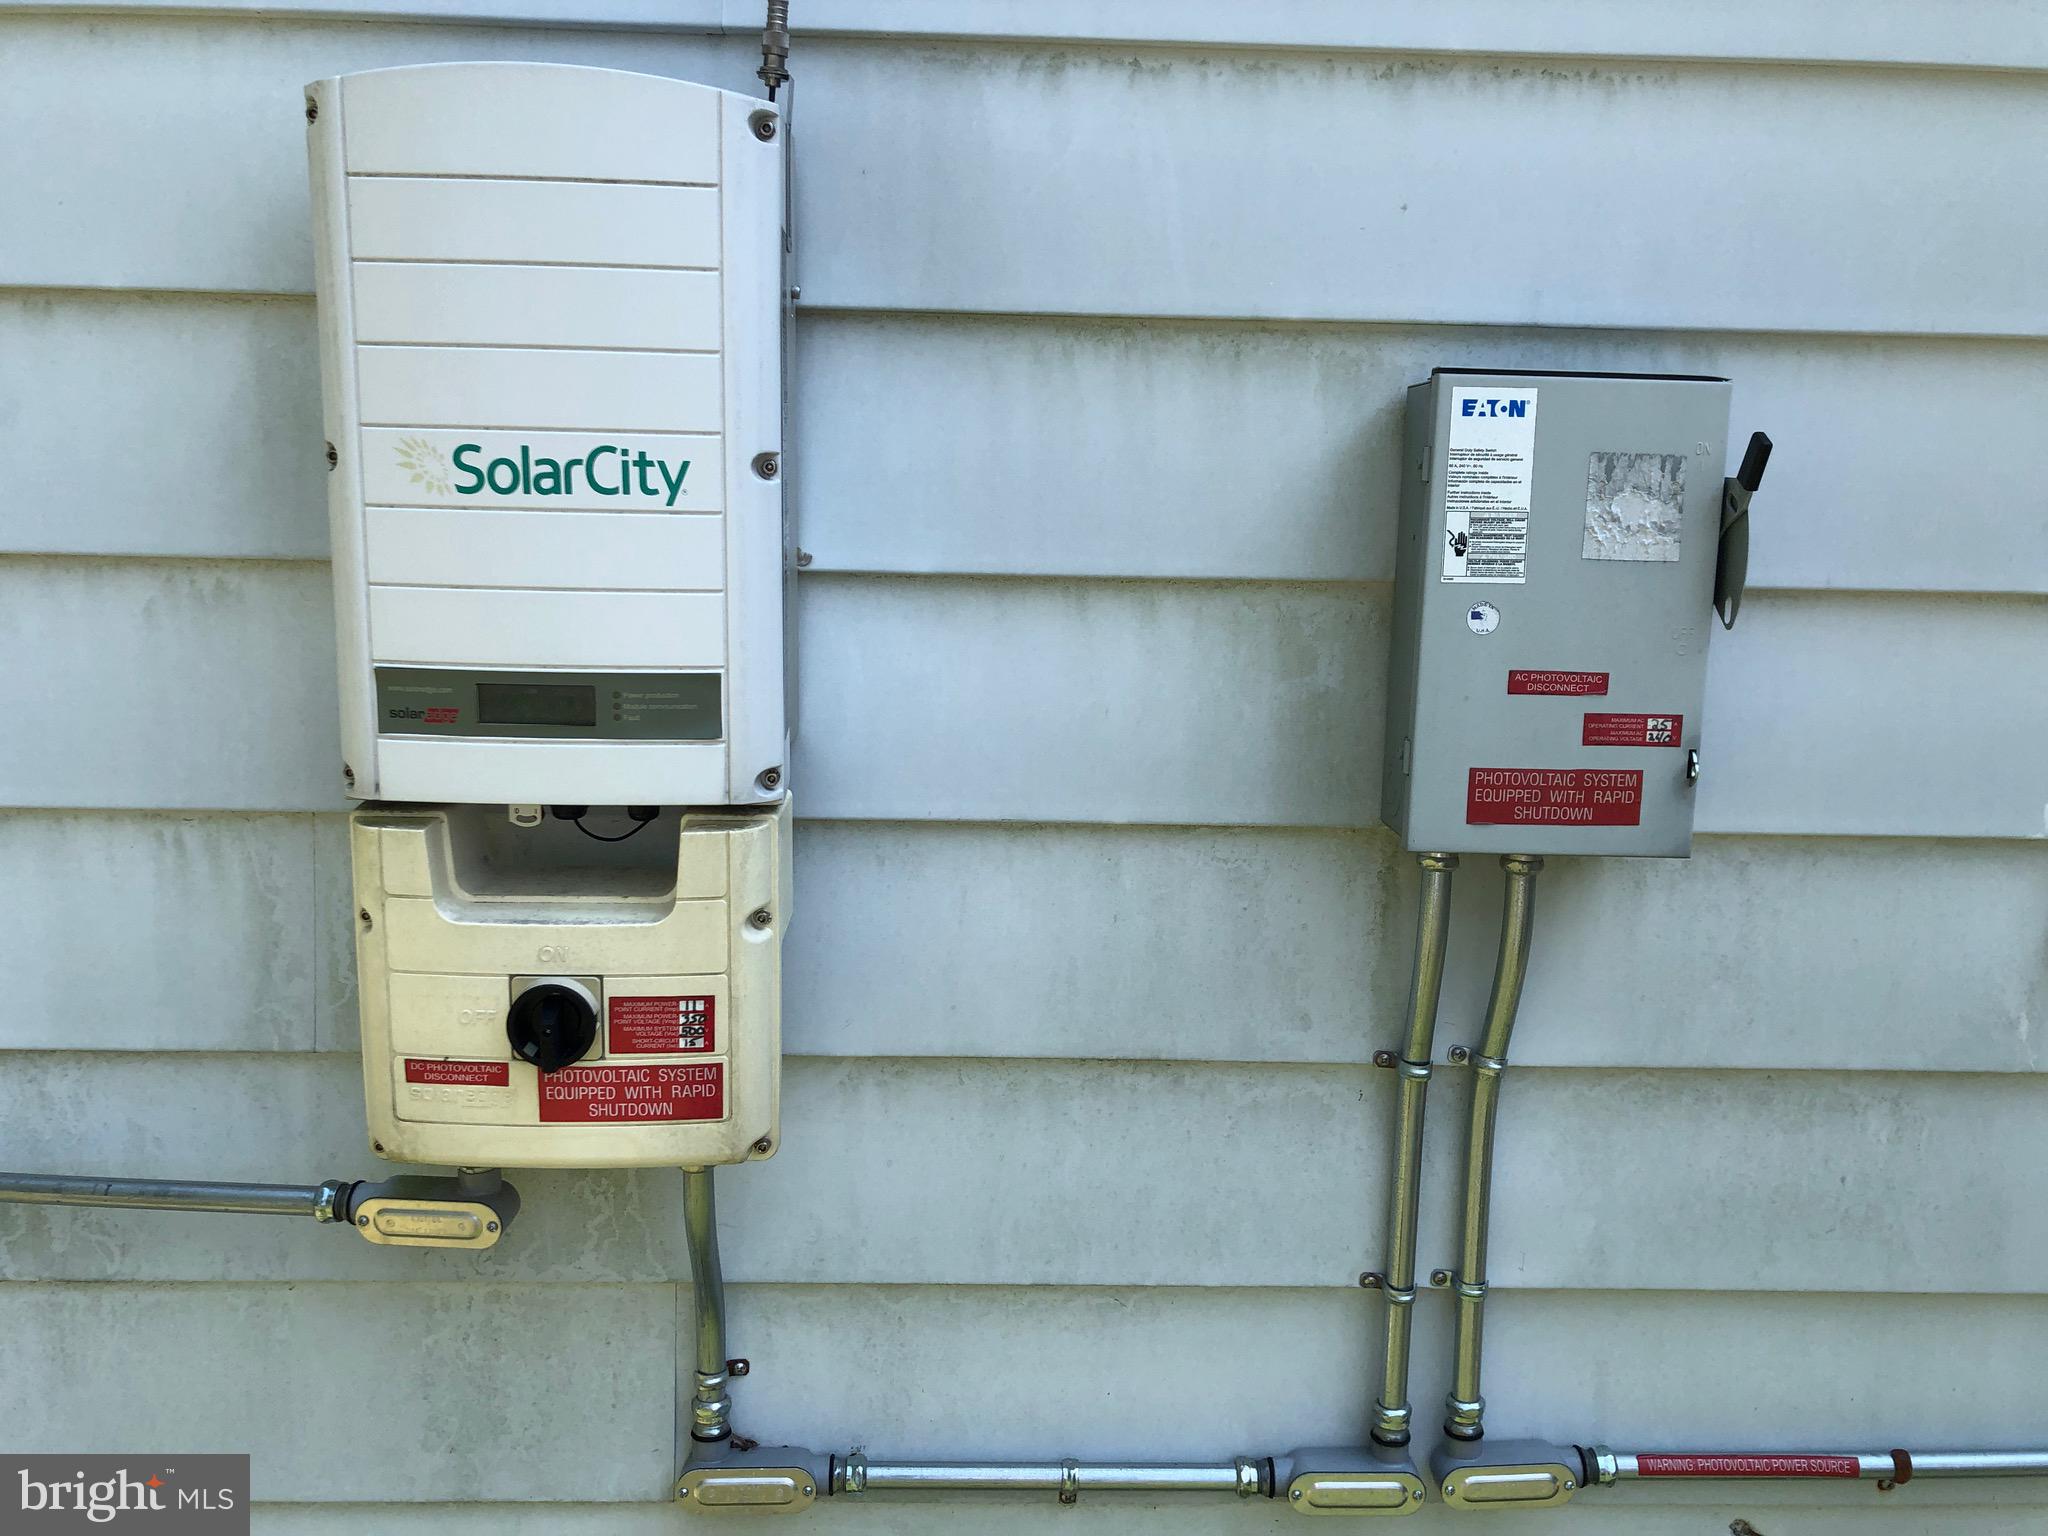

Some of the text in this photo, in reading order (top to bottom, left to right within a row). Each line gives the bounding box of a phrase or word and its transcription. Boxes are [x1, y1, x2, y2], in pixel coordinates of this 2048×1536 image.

[1462, 398, 1526, 417] EATON
[453, 444, 690, 506] SolarCity
[1531, 674, 1602, 683] PHOTOVOLTAIC
[1527, 683, 1589, 692] DISCONNECT
[1475, 772, 1637, 787] PHOTOVOLTAIC SYSTEM
[1474, 789, 1634, 804] EQUIPPED WITH RAPID
[1514, 806, 1593, 820] SHUTDOWN
[537, 945, 569, 962] ON
[411, 1062, 502, 1073] DC PHOTOVOLTAIC
[544, 1067, 717, 1083] PHOTOVOLTAIC SYSTEM
[424, 1073, 488, 1082] DISCONNECT
[546, 1084, 716, 1100] EQUIPPED WITH RAPID
[589, 1102, 673, 1117] SHUTDOWN
[1698, 1459, 1771, 1472] PHOTOVOLTAIC
[1773, 1459, 1808, 1472] POWER
[1810, 1460, 1850, 1473] SOURCE
